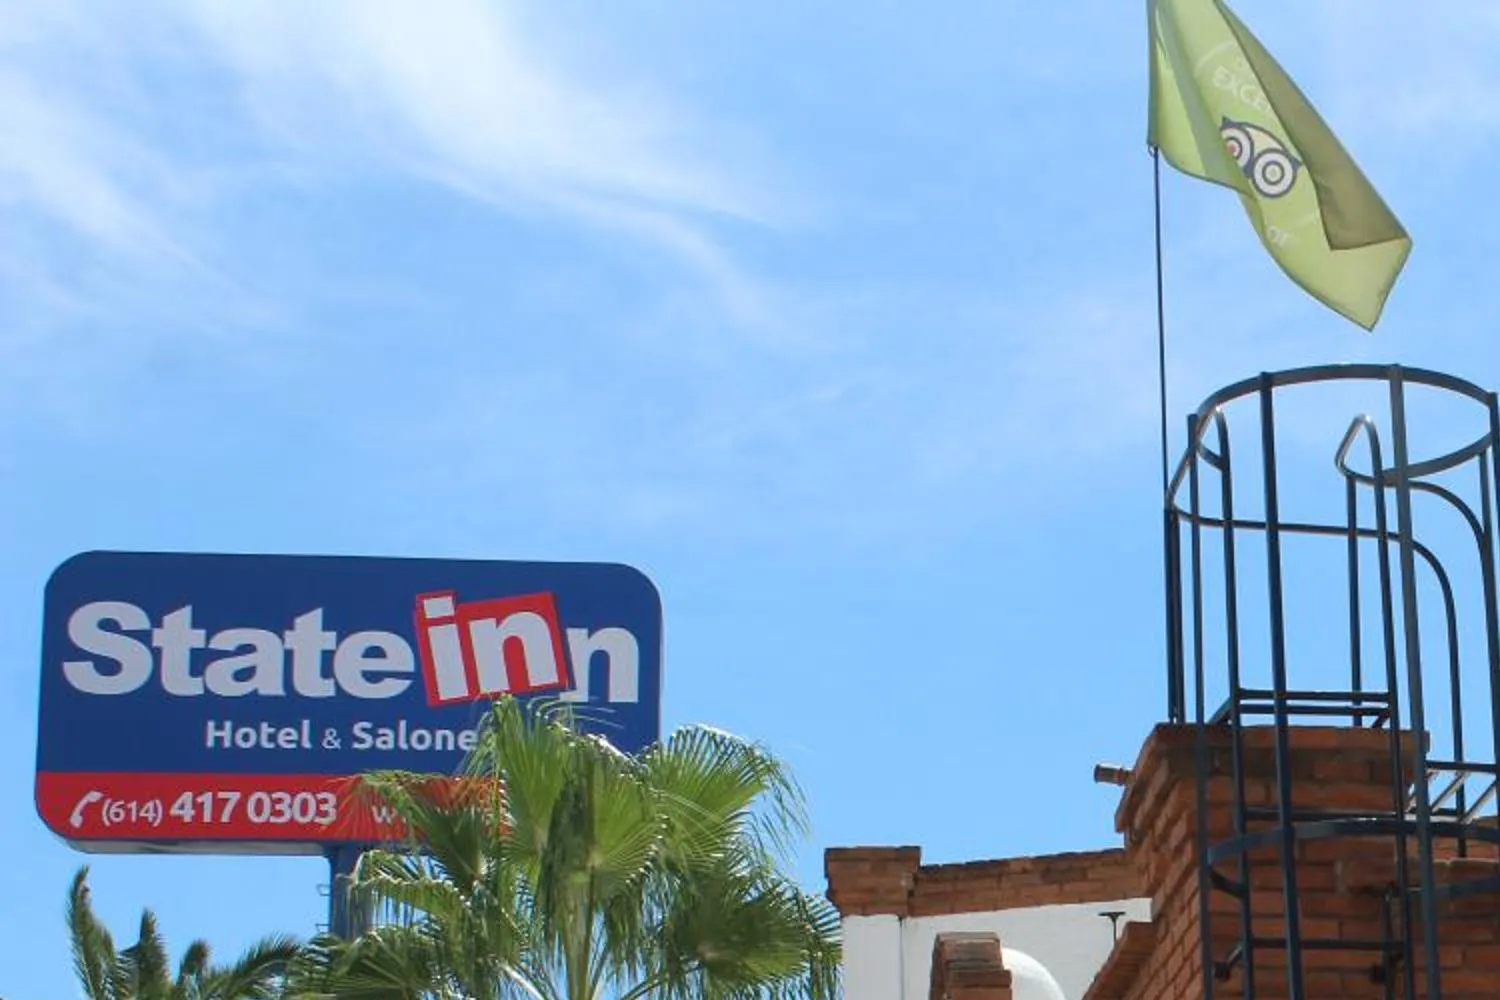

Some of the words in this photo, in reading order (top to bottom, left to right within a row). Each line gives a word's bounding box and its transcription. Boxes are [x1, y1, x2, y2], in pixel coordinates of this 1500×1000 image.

[206, 721, 311, 750] Hotel
[322, 729, 341, 749] &
[352, 720, 480, 751] Salone
[101, 799, 163, 826] (614)
[169, 791, 241, 823] 417
[246, 792, 337, 825] 0303
